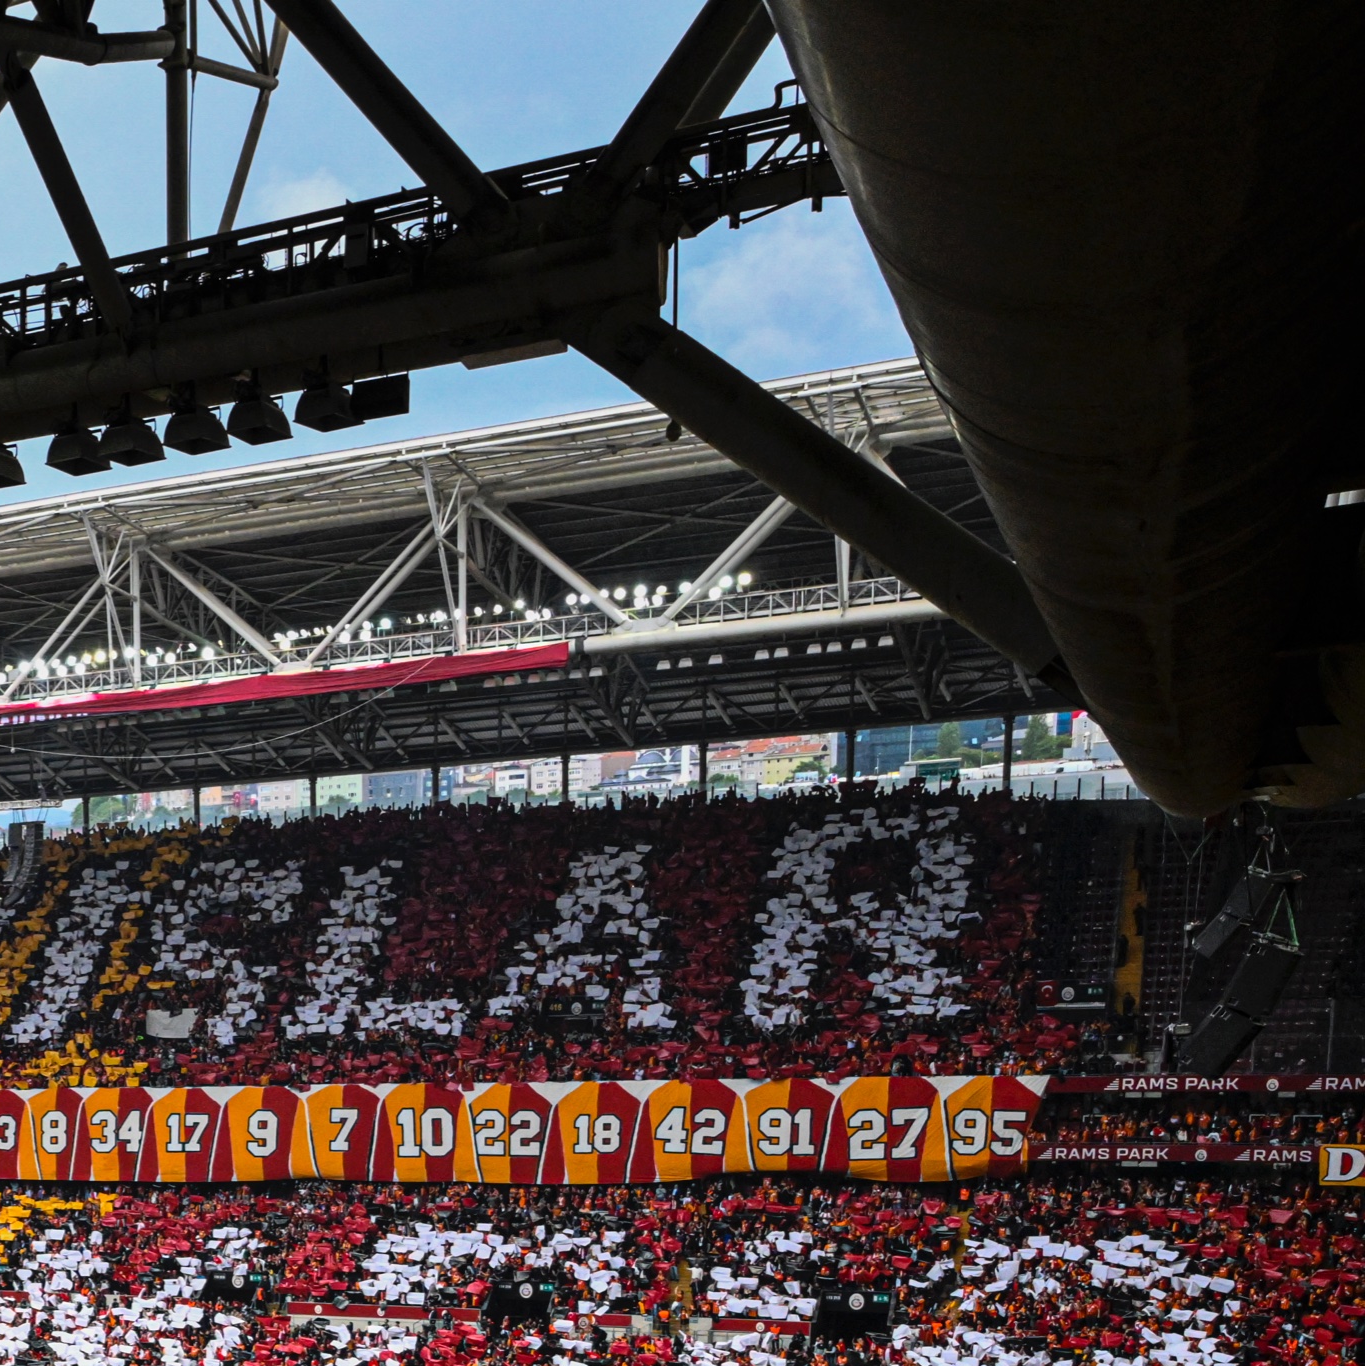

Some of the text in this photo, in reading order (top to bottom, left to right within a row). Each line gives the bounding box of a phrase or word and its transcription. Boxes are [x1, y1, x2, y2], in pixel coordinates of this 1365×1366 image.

[1122, 1077, 1239, 1091] RAMS PARK
[40, 1110, 68, 1154] 8
[90, 1108, 143, 1153] 34
[166, 1112, 210, 1152] 17
[246, 1109, 279, 1157] 9
[328, 1107, 359, 1153] 7
[396, 1107, 455, 1158] 10
[473, 1108, 544, 1157] 22
[572, 1113, 622, 1155] 18
[654, 1107, 728, 1156] 42
[756, 1107, 816, 1156] 91
[847, 1107, 930, 1161] 27
[951, 1107, 1027, 1156] 95
[1054, 1147, 1169, 1161] RAMS PARK
[1253, 1149, 1312, 1163] RAMS
